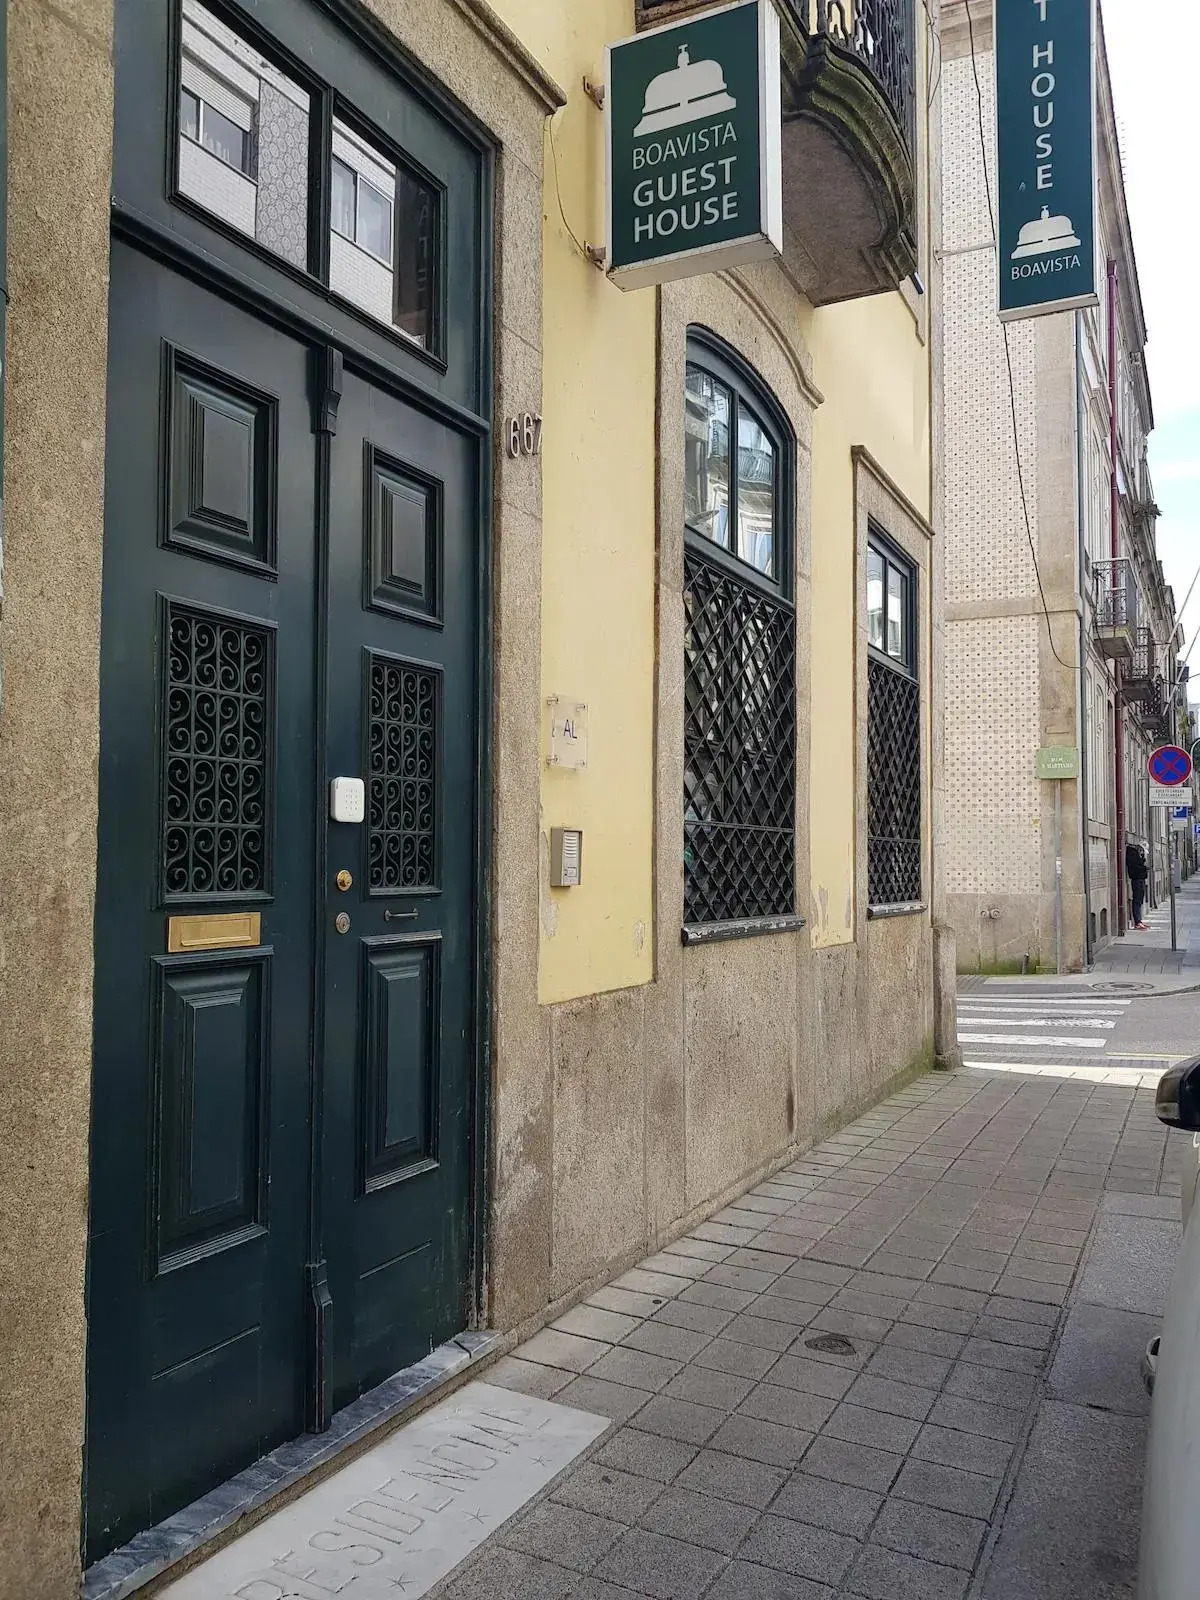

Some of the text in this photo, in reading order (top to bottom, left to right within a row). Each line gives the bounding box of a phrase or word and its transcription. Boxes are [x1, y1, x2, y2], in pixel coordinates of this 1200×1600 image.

[1031, 40, 1055, 190] HOUSE
[633, 121, 737, 170] BOAVISTA
[633, 156, 737, 207] GUEST
[634, 191, 738, 243] HOUSE
[1011, 254, 1081, 280] BOAVISTA
[508, 413, 544, 458] 667
[563, 719, 578, 739] AL
